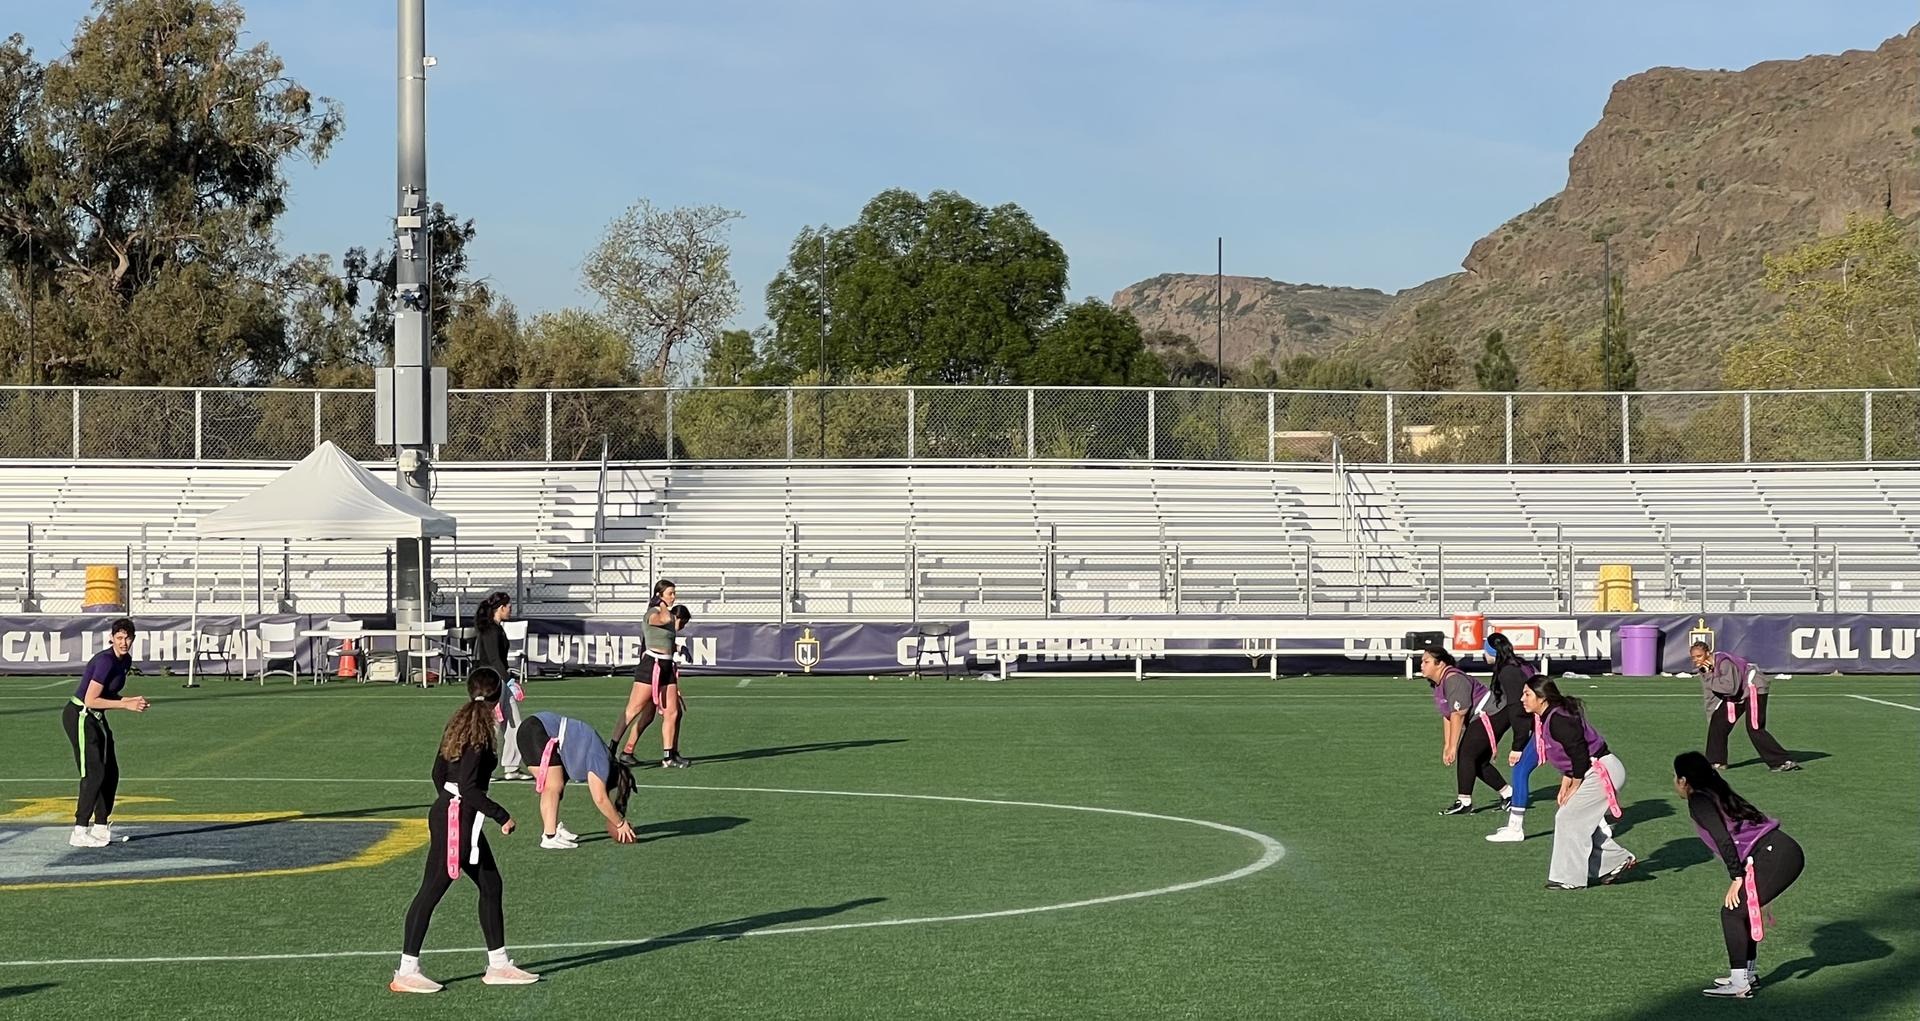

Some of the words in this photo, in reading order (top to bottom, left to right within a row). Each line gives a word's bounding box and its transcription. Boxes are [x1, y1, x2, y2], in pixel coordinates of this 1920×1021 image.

[3, 631, 69, 661] CAL
[897, 636, 964, 666] CAL
[1791, 628, 1859, 659] CAL
[1870, 628, 1920, 659] LU
